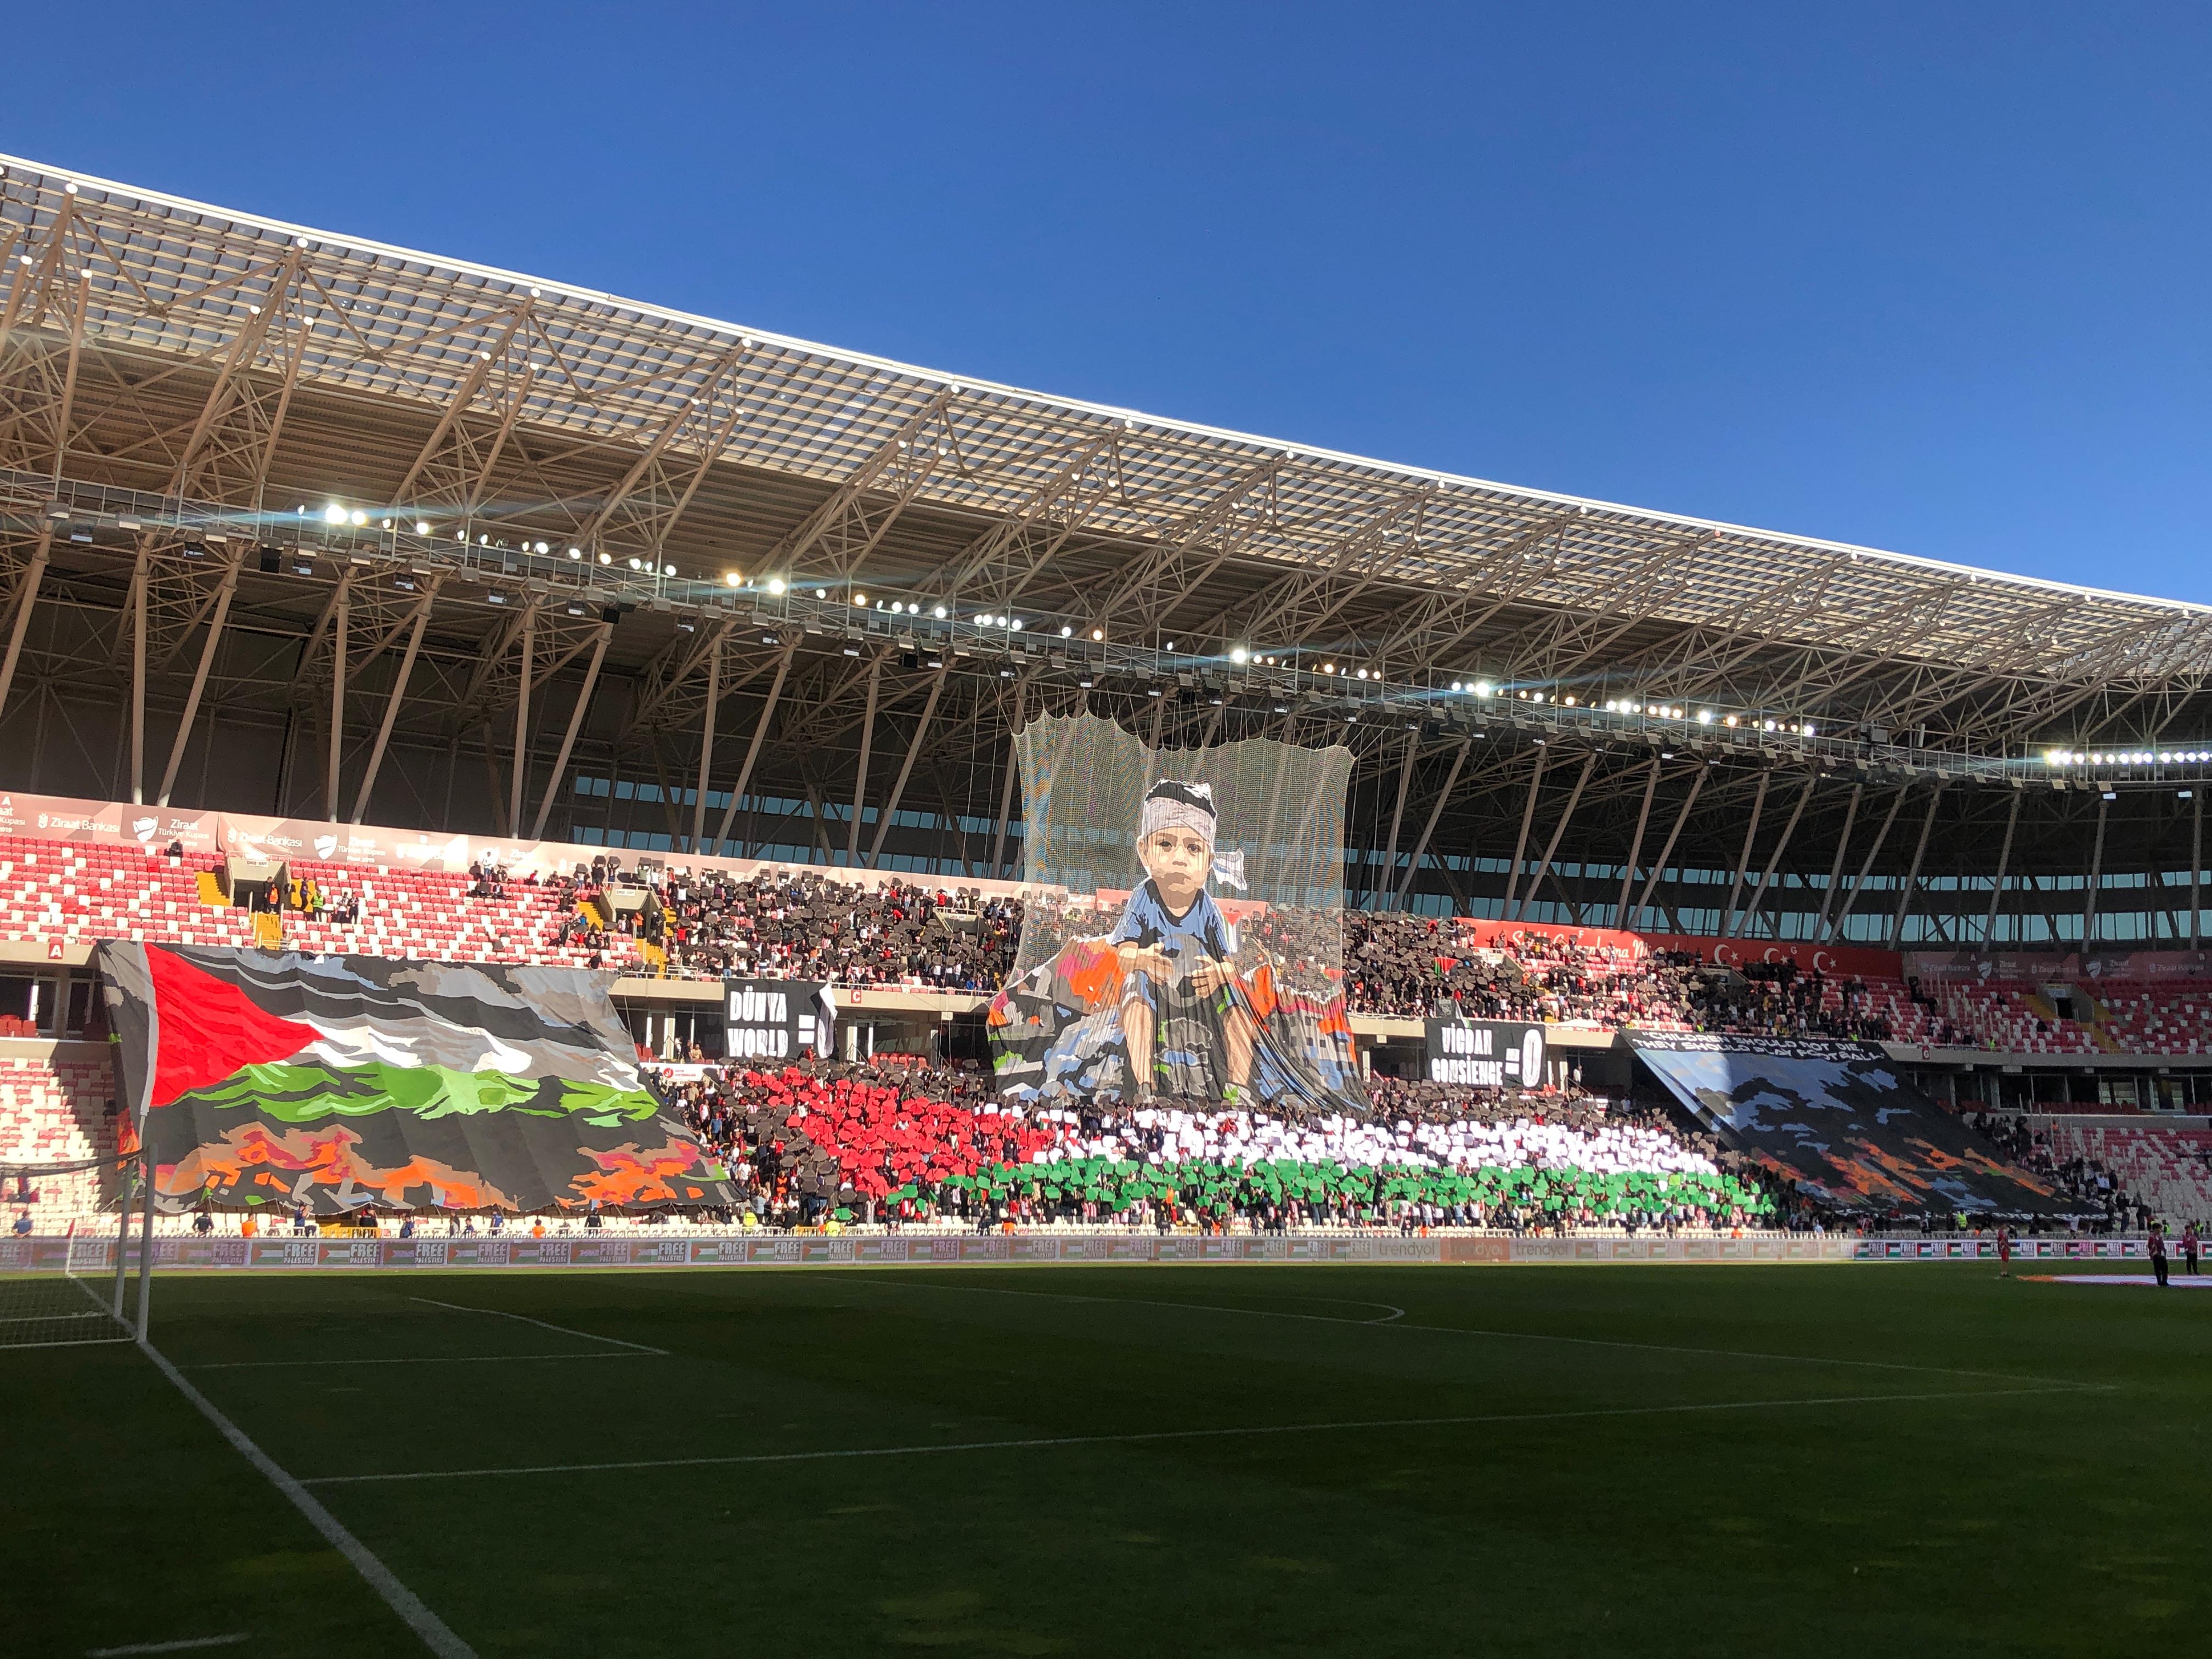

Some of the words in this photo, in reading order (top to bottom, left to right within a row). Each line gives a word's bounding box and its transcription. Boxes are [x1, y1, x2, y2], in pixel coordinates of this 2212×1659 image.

[50, 817, 81, 830] Ziraat
[82, 821, 120, 833] Bankası
[170, 818, 199, 831] Ziraat
[158, 827, 184, 838] Türkiye
[267, 835, 302, 848] Bankası
[1579, 930, 1584, 939] F
[50, 945, 62, 957] A
[1791, 946, 1797, 955] G
[853, 991, 861, 1002] C
[730, 985, 787, 1023] DÜNYA
[727, 1028, 788, 1058] WORLD
[1441, 1023, 1493, 1056] VİCDAN
[1733, 1036, 1797, 1048] SHOULD
[1798, 1040, 1829, 1051] NOT
[1632, 1039, 1677, 1050] THEY
[1681, 1041, 1751, 1052] SHOULD
[1753, 1046, 1792, 1057] PLAY
[1923, 1050, 1929, 1058] G
[1431, 1056, 1503, 1086] CONSİENCE
[285, 1243, 315, 1257] FREE
[351, 1244, 380, 1257] FREE
[416, 1244, 444, 1257] FREE
[478, 1243, 506, 1256] FREE
[540, 1243, 568, 1256] FREE
[600, 1243, 627, 1256] FREE
[659, 1242, 685, 1255] FREE
[719, 1242, 744, 1255] FREE
[775, 1242, 799, 1254] FREE
[828, 1241, 853, 1254] FREE
[881, 1240, 905, 1253] FREE
[934, 1240, 957, 1252] FREE
[984, 1240, 1007, 1252] FREE
[1033, 1239, 1056, 1251] FREE
[1083, 1240, 1105, 1251] FREE
[1130, 1239, 1151, 1251] FREE
[1176, 1239, 1198, 1251] FREE
[1221, 1240, 1242, 1251] FREE
[1264, 1240, 1285, 1251] FREE
[1351, 1241, 1370, 1251] FREE
[1379, 1242, 1435, 1259] trendyol
[1516, 1242, 1568, 1259] trendyol
[1869, 1243, 1884, 1252] FREE
[1900, 1243, 1915, 1252] FREE
[1931, 1243, 1945, 1252] FREE
[1961, 1243, 1974, 1251] FREE
[2020, 1242, 2033, 1251] FREE
[2051, 1242, 2063, 1251] FREE
[2107, 1243, 2120, 1251] FREE
